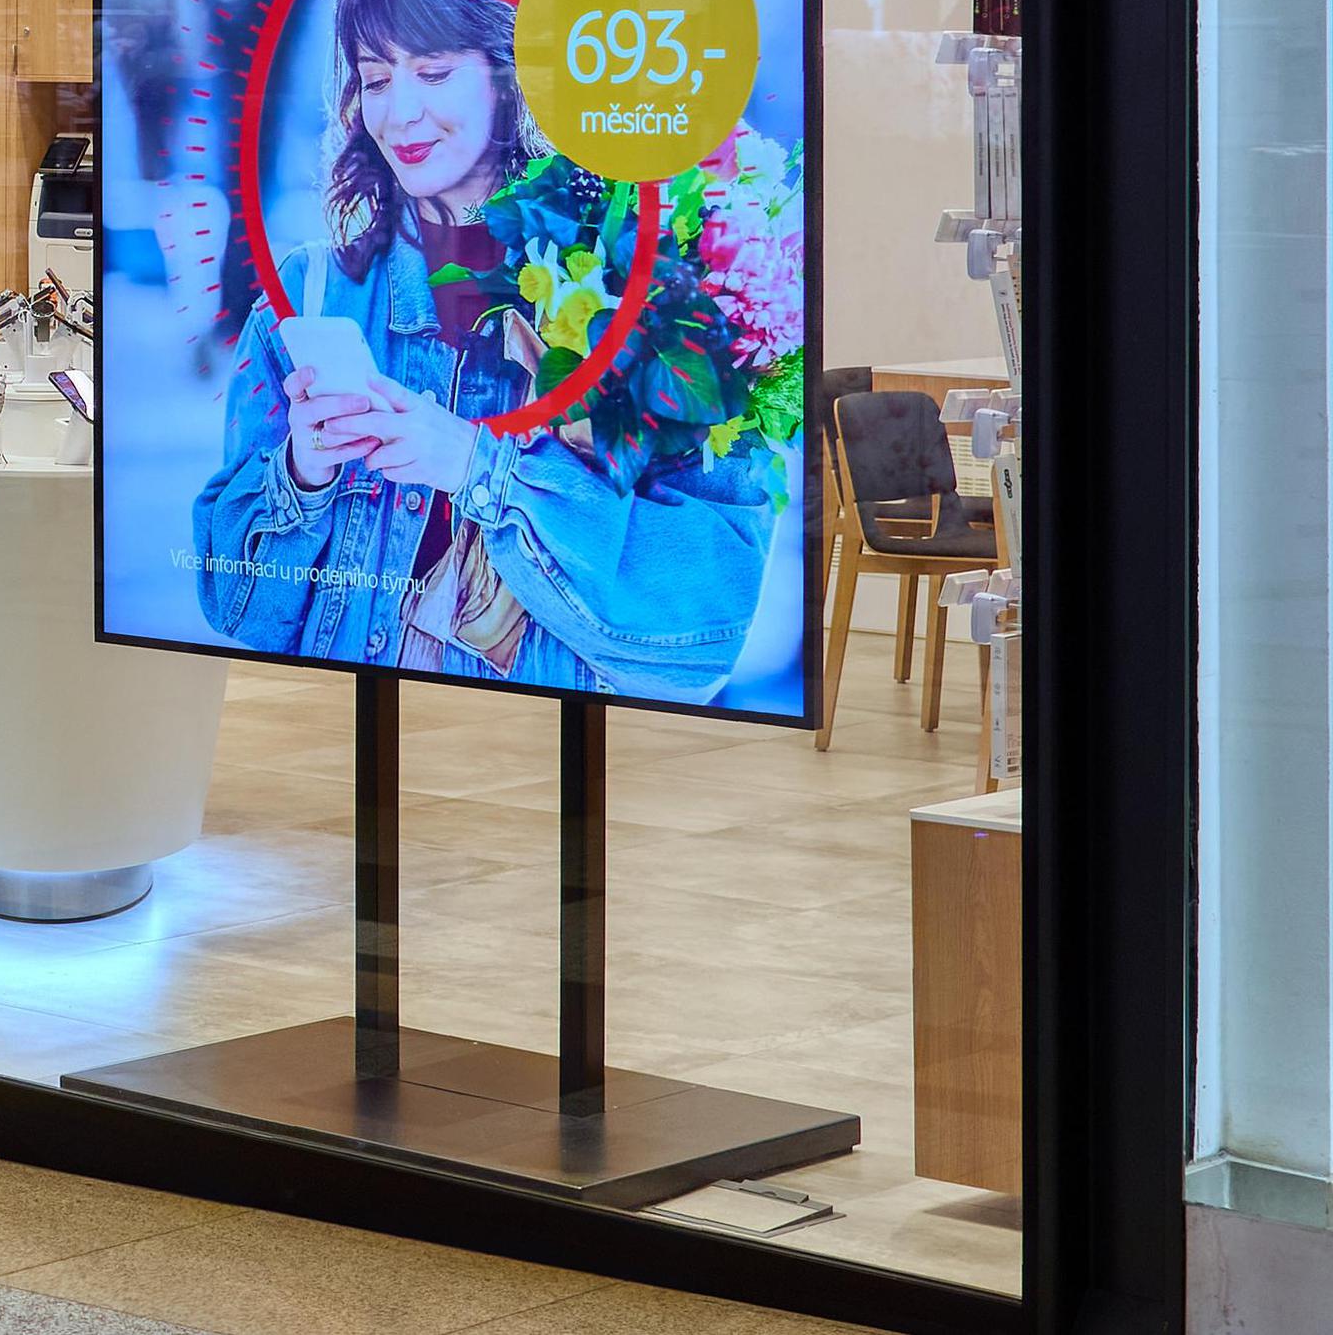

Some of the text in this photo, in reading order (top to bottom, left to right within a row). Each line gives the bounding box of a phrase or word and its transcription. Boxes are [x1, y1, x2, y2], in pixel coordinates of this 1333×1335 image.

[567, 9, 726, 94] 693,-
[581, 103, 689, 135] měsíčně
[170, 548, 426, 596] Více informací u prodejního týmu
